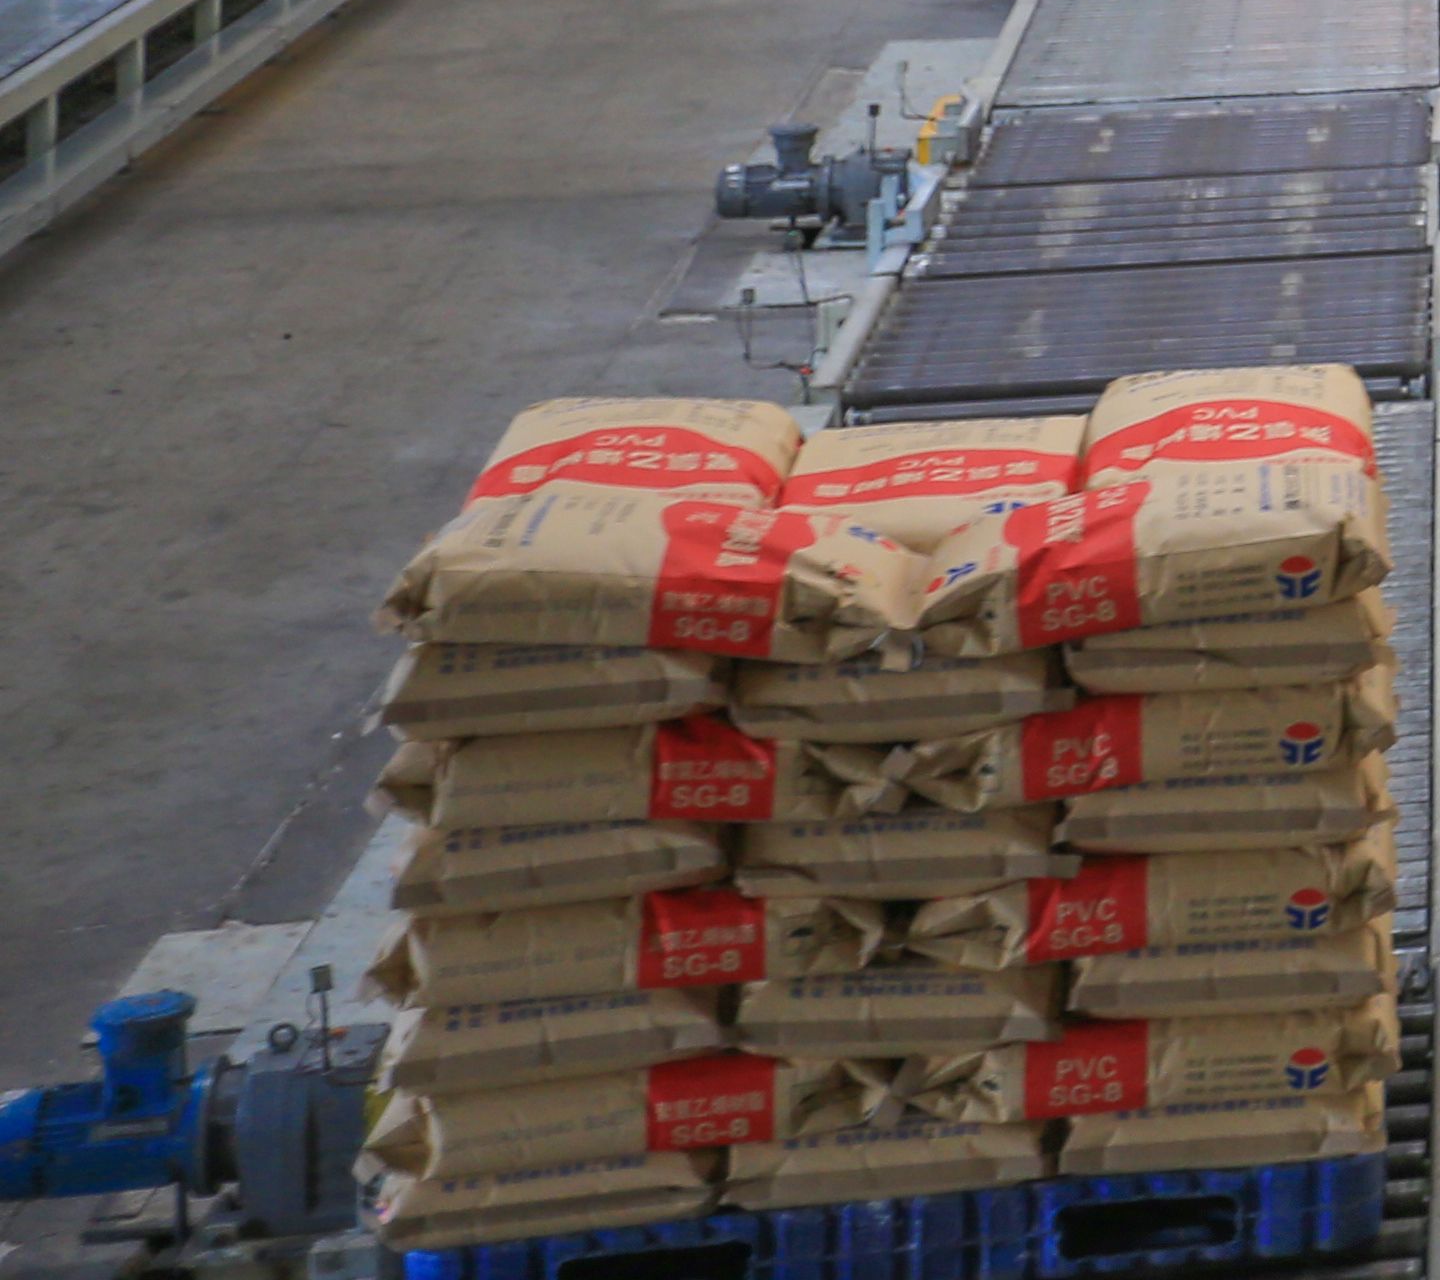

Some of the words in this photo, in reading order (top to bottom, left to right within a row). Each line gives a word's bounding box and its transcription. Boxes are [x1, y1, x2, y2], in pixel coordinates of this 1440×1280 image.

[1192, 406, 1260, 422] PVC
[594, 433, 668, 449] PVC
[896, 455, 967, 471] PVC
[1047, 575, 1109, 602] PVC
[1041, 599, 1117, 632] SG-8
[673, 616, 750, 643] SG-8
[1053, 733, 1112, 761] PVC
[1047, 755, 1121, 788] SG-8
[670, 785, 750, 810] SG-8
[1056, 897, 1118, 924] PVC
[1050, 923, 1126, 951] SG-8
[663, 948, 742, 979] SG-8
[1055, 1055, 1118, 1082] PVC
[1049, 1082, 1123, 1107] SG-8
[671, 1117, 749, 1145] SG-8
